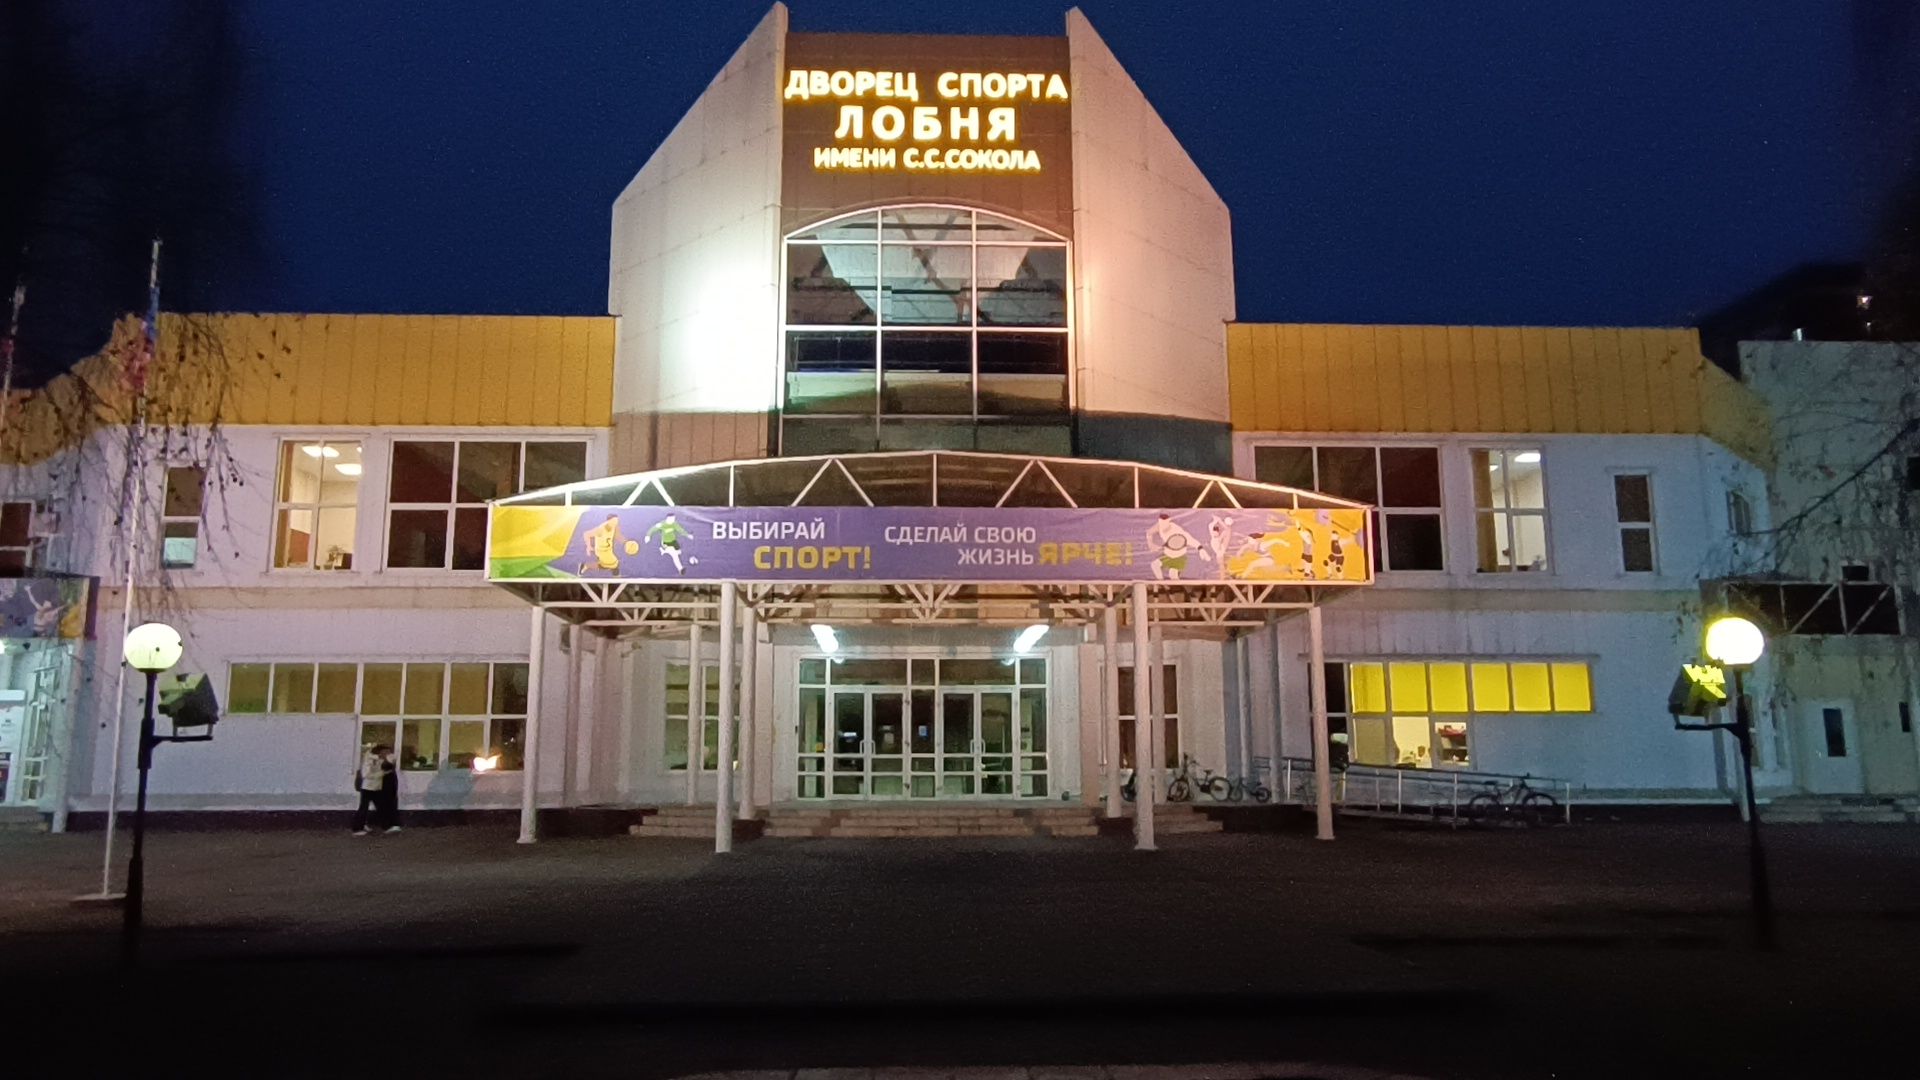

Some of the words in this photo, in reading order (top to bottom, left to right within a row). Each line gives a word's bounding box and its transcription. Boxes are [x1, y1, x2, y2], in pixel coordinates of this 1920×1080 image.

[784, 70, 919, 101] ДВОРЕЦ
[937, 72, 1069, 99] СПОРТА
[835, 105, 1016, 140] ЛОБНЯ
[814, 147, 896, 168] ИМЕНИ
[712, 517, 826, 540] ВЫБИРАЙ
[884, 523, 968, 545] СДЕЛАЙ
[974, 526, 1036, 543] СВОЮ
[753, 545, 871, 569] СПОРТ!
[957, 548, 1034, 565] ЖИЗНЬ
[1038, 542, 1133, 566] ЯРЧЕ!
